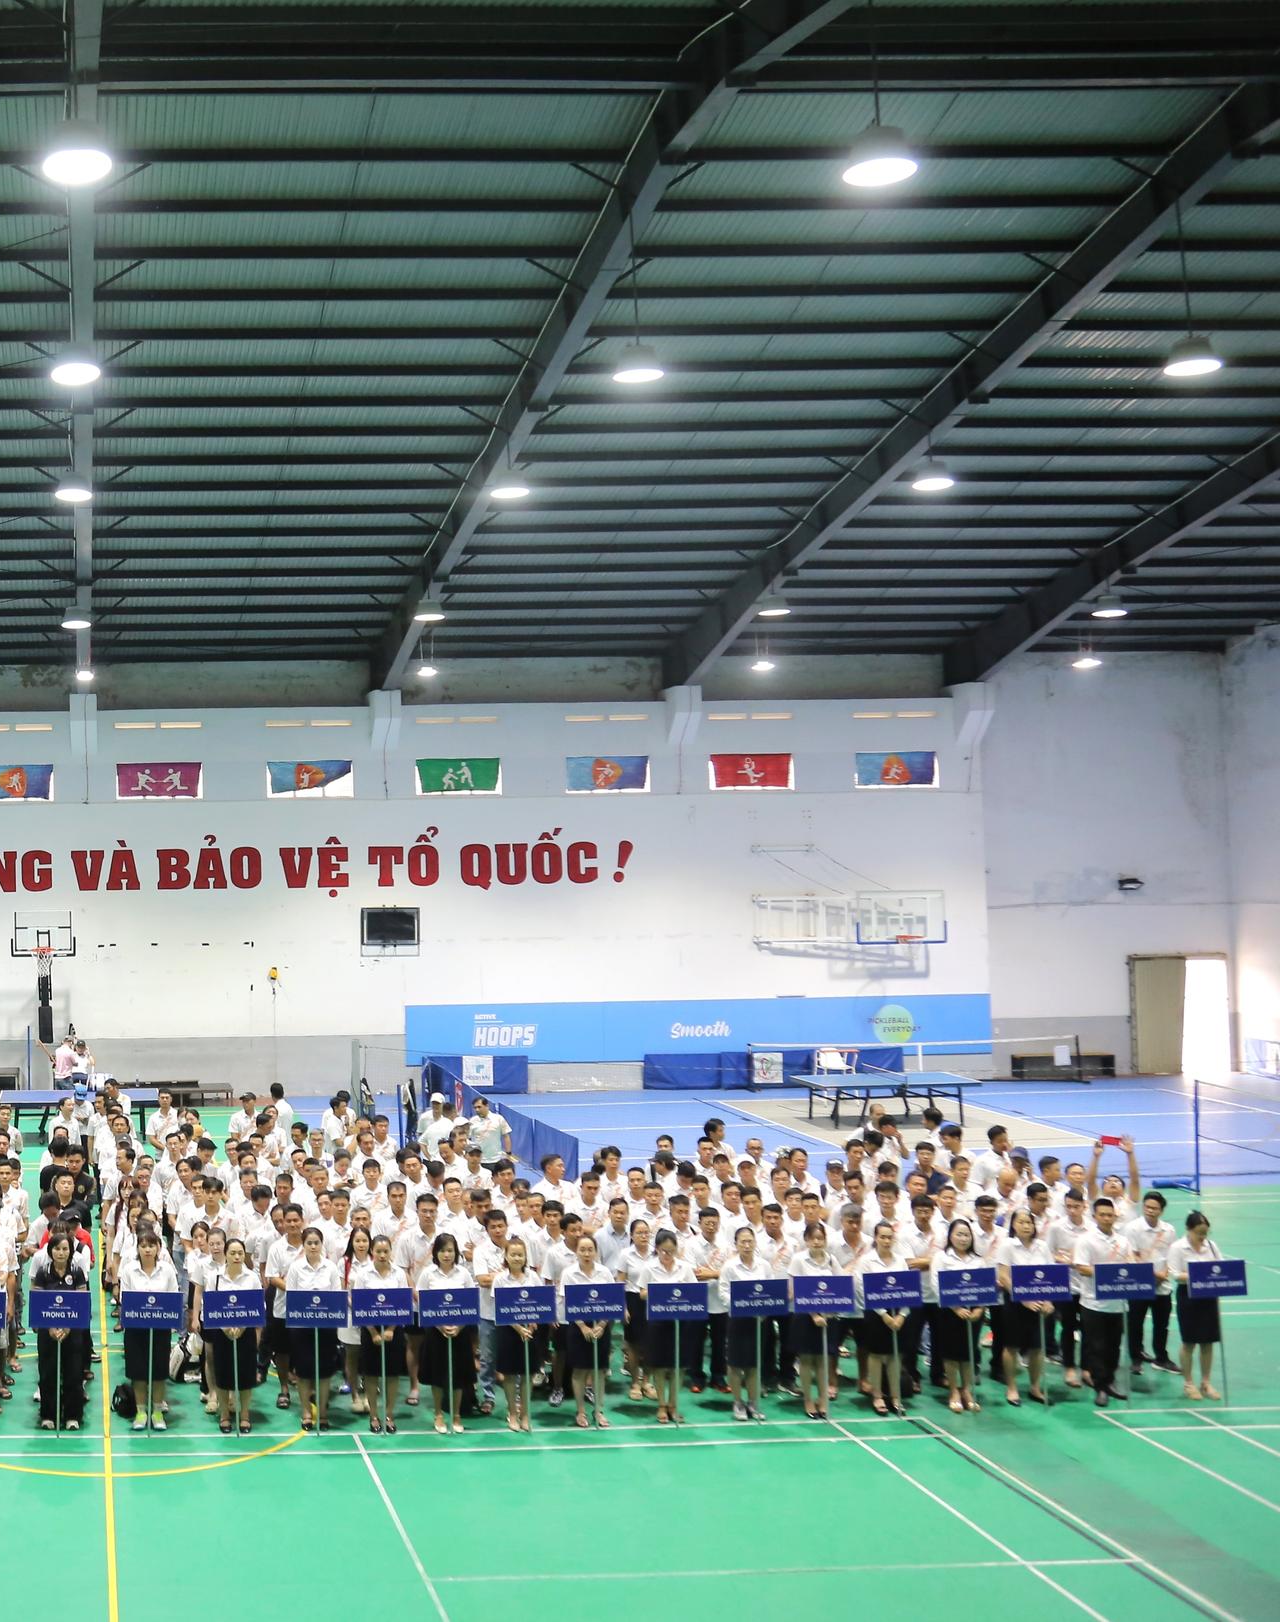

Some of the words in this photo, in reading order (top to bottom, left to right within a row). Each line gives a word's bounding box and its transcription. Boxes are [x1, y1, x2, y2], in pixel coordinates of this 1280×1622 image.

[70, 840, 141, 891] VÀ
[157, 834, 263, 890] BẢO
[279, 836, 349, 898] VỆ
[367, 826, 440, 887] TỔ
[460, 827, 599, 890] QUỐC
[671, 1020, 732, 1039] Smooth
[472, 1024, 538, 1048] HOOPS
[41, 1311, 66, 1319] TRỌNG
[125, 1310, 139, 1319] ĐIỆN
[152, 1311, 162, 1319] HẢI
[163, 1311, 179, 1319] CHÂU
[208, 1311, 222, 1319] ĐIỆN
[223, 1311, 235, 1319] LỰC
[235, 1310, 248, 1318] SƠN
[248, 1309, 261, 1317] TRÀ
[289, 1311, 302, 1319] ĐIỆN
[303, 1311, 314, 1319] LỰC
[315, 1311, 328, 1319] LIÊN
[329, 1311, 346, 1319] CHIỂU
[355, 1310, 368, 1318] ĐIỆN
[368, 1310, 379, 1318] LỰC
[422, 1310, 436, 1318] ĐIỆN
[437, 1309, 448, 1317] LỰC
